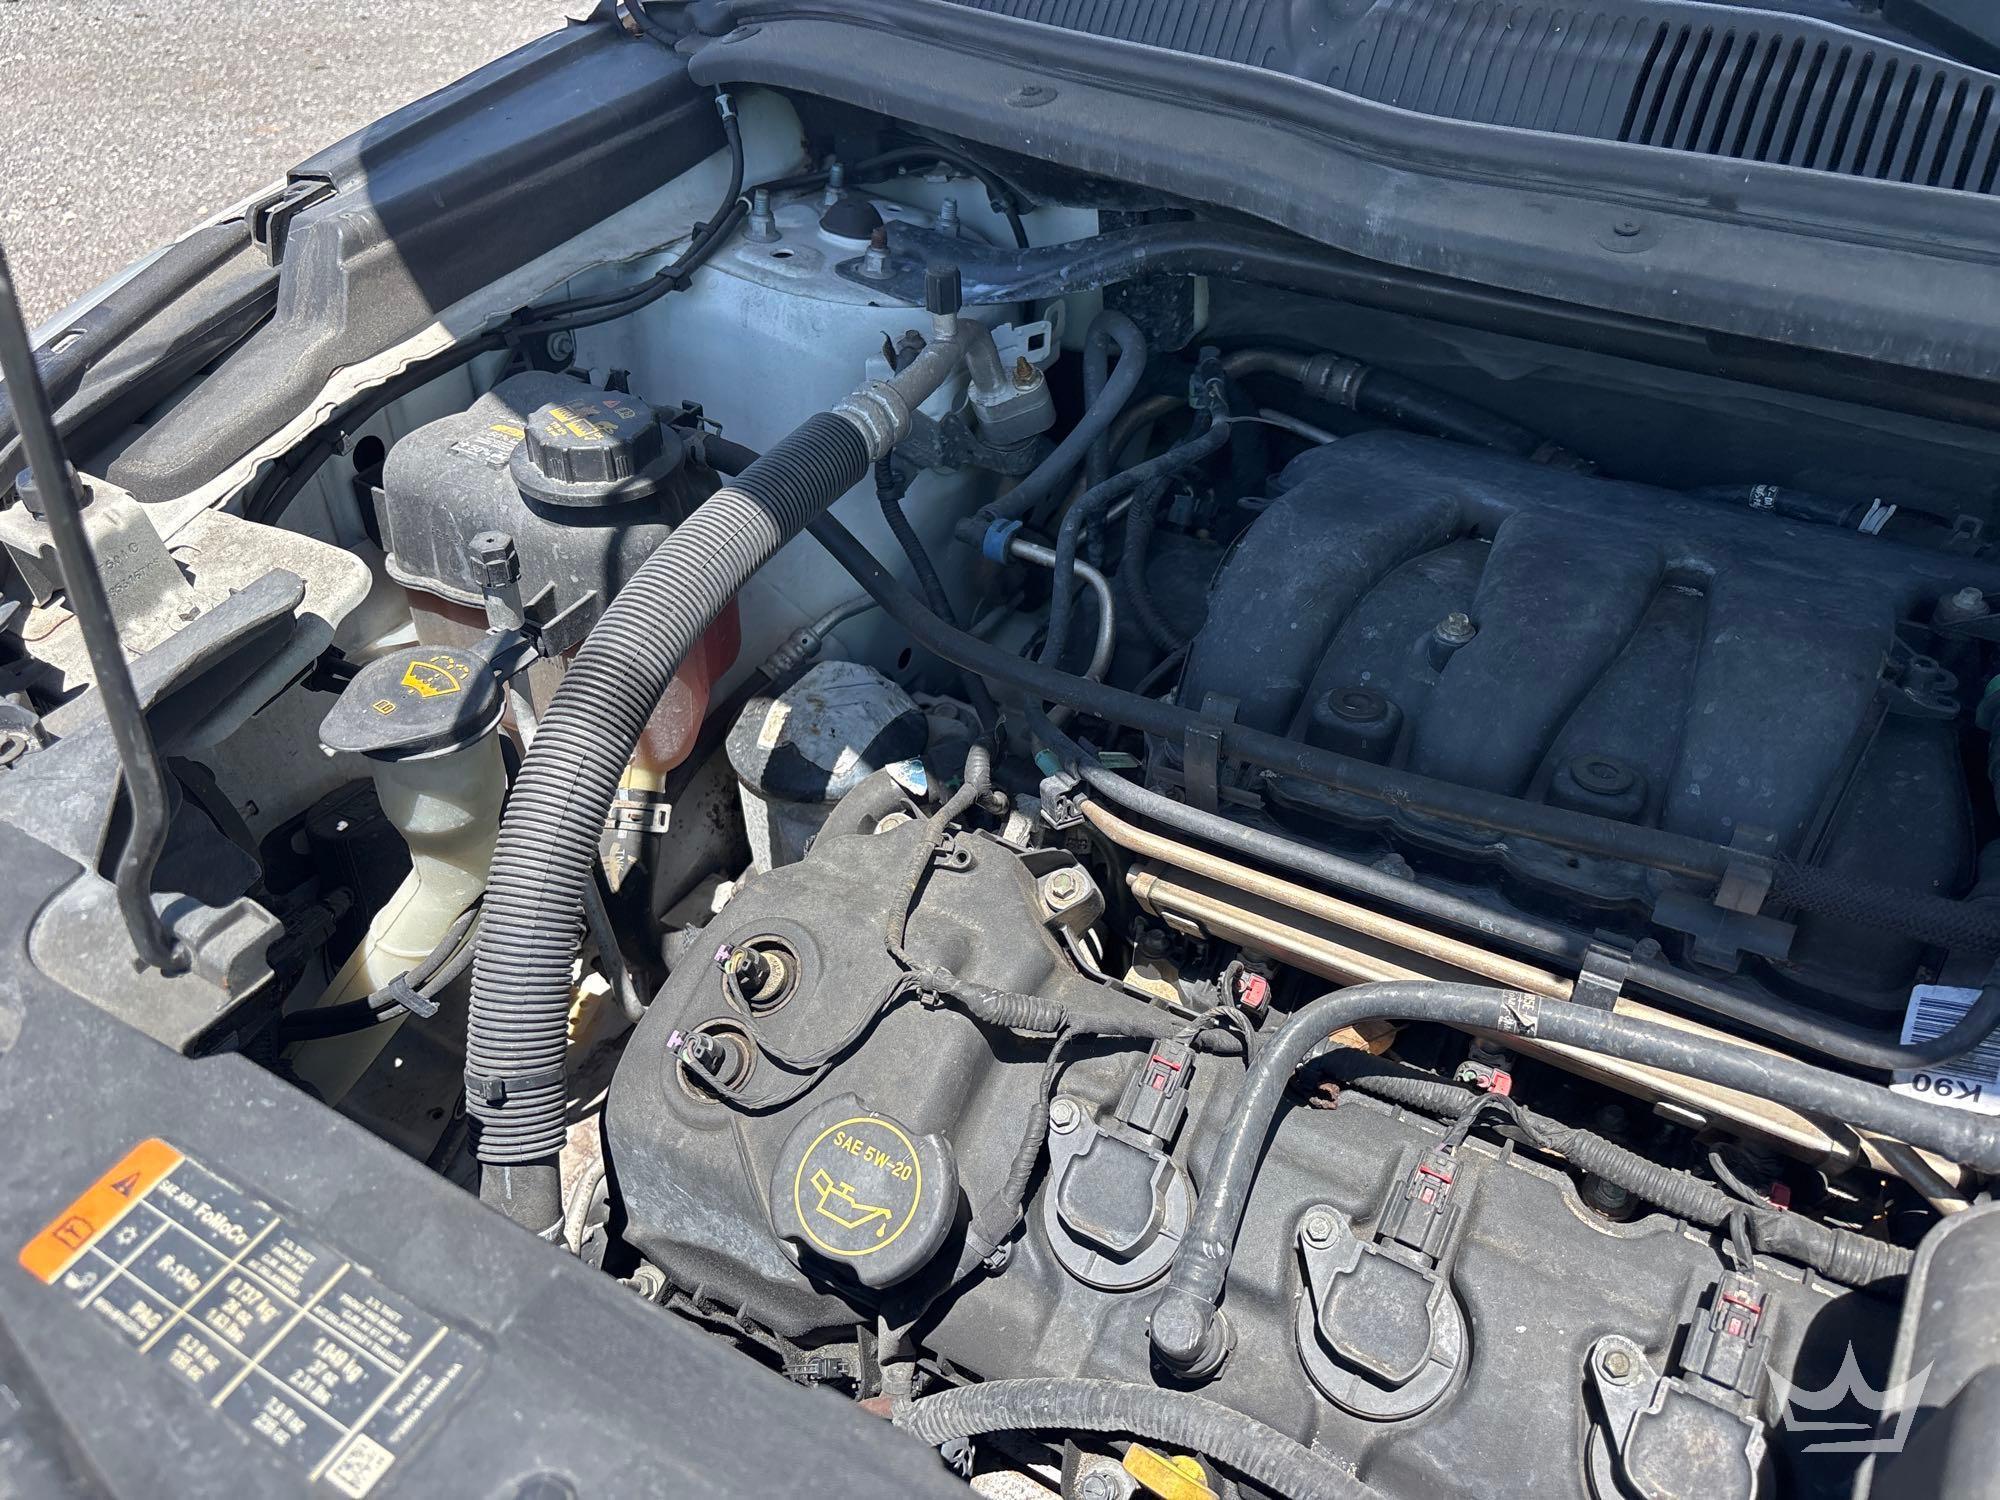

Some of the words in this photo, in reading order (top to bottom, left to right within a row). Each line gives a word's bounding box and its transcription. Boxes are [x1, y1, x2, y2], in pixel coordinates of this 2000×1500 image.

[1911, 1073, 1982, 1103] K90
[833, 1131, 865, 1157] SAE
[863, 1146, 913, 1181] 5W-20
[191, 1201, 251, 1246] FoMoCo
[155, 1253, 205, 1292] R-134a
[224, 1276, 264, 1307] 0.737
[251, 1298, 281, 1324] kg
[338, 1358, 367, 1384] kg
